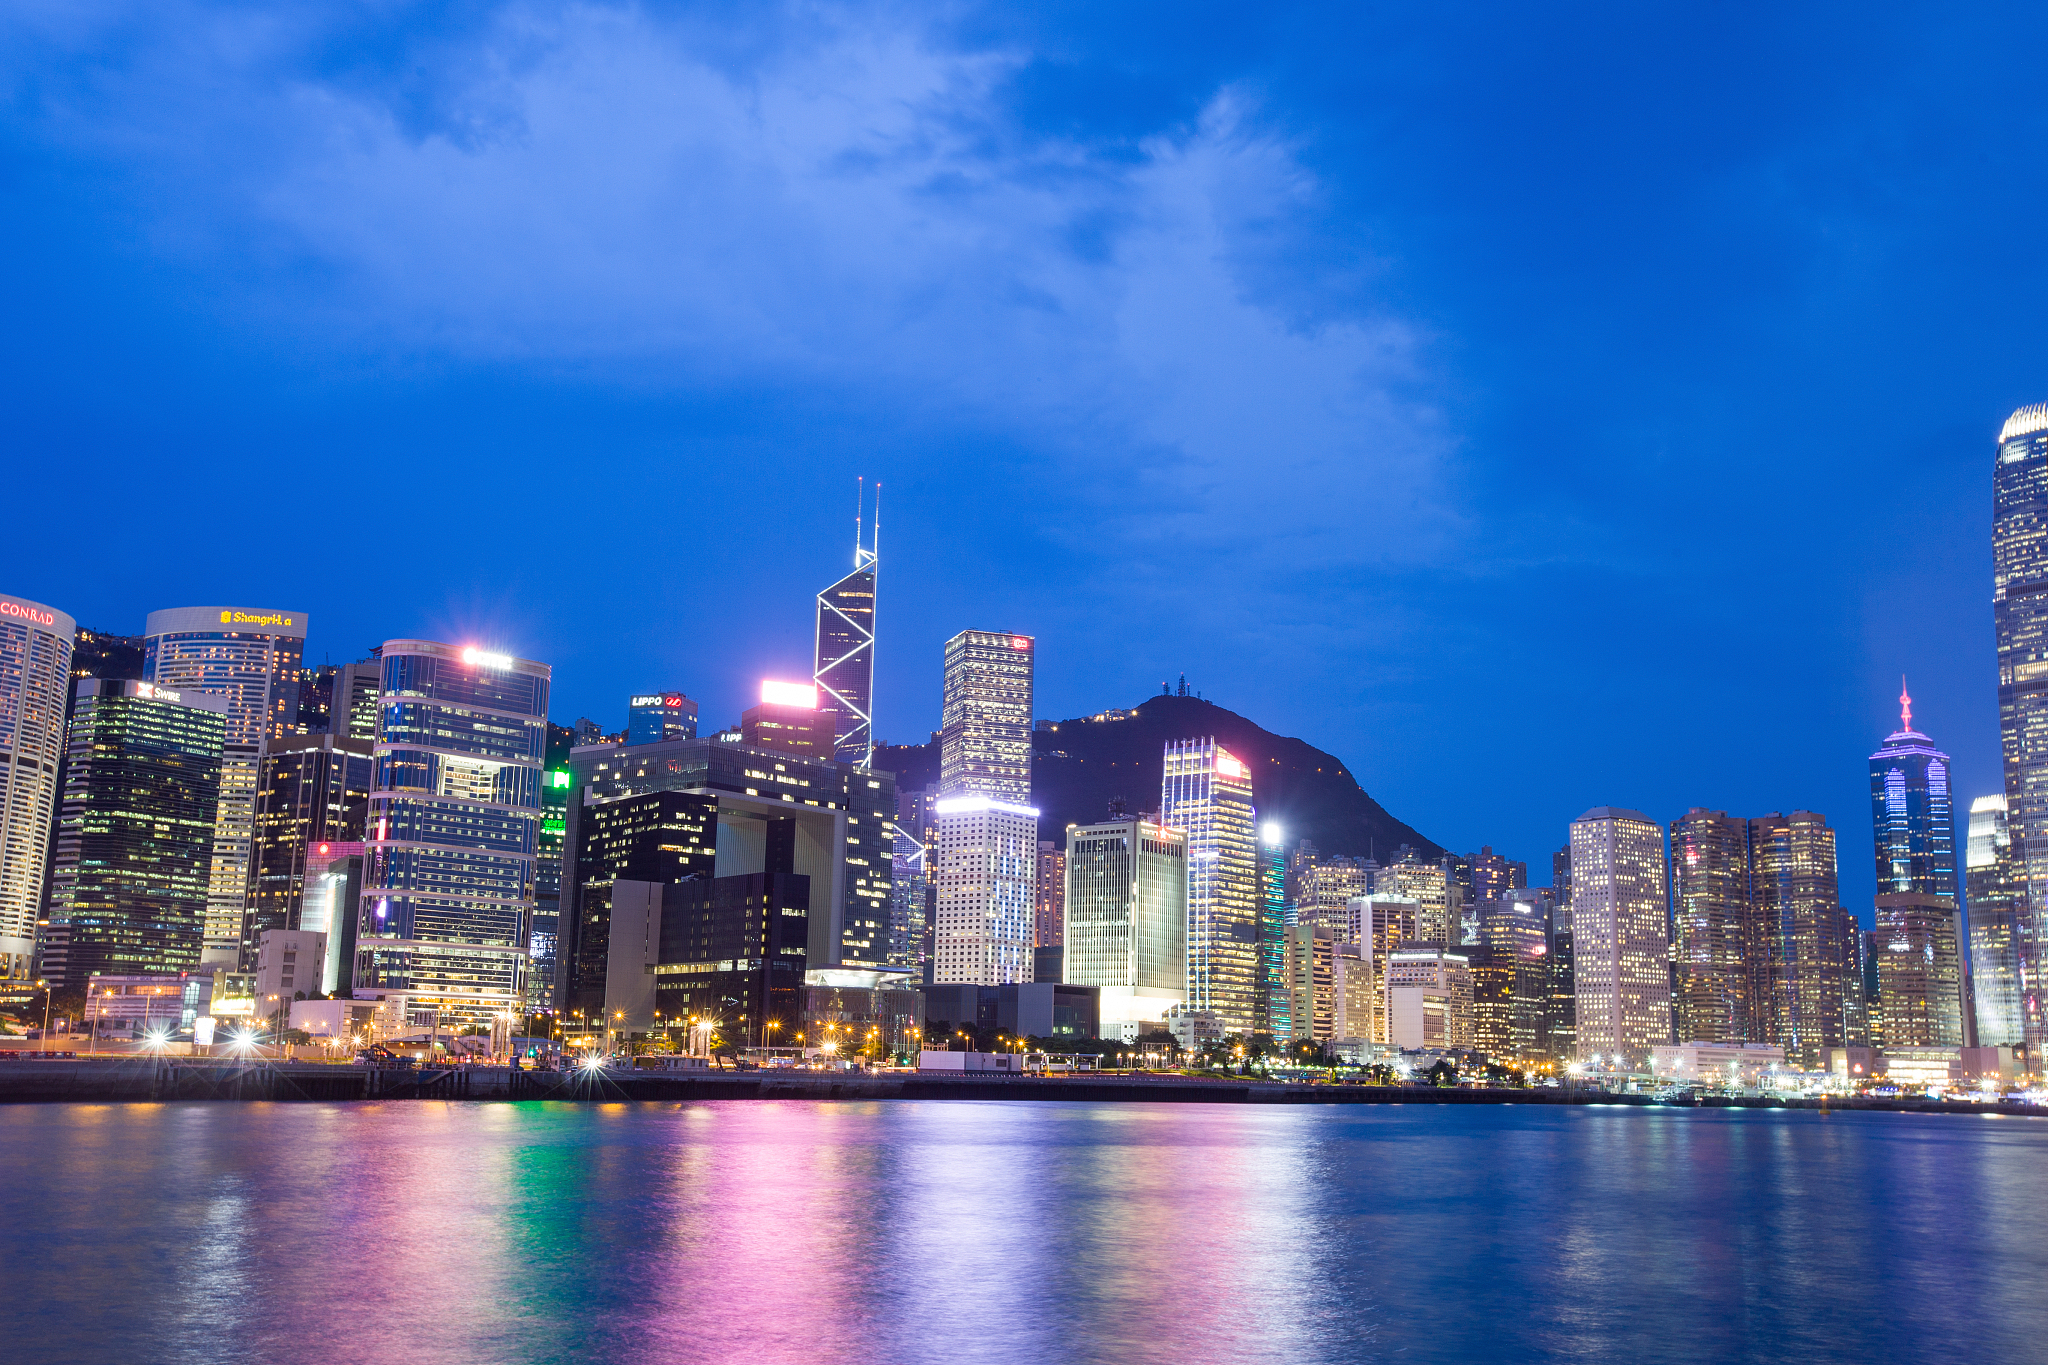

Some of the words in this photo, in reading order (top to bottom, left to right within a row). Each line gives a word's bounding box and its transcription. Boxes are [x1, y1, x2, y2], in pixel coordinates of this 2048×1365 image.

[0, 602, 54, 625] CONRAD
[233, 611, 292, 626] Shangri-La
[631, 696, 663, 706] LIPPO
[720, 733, 742, 743] LIPP
